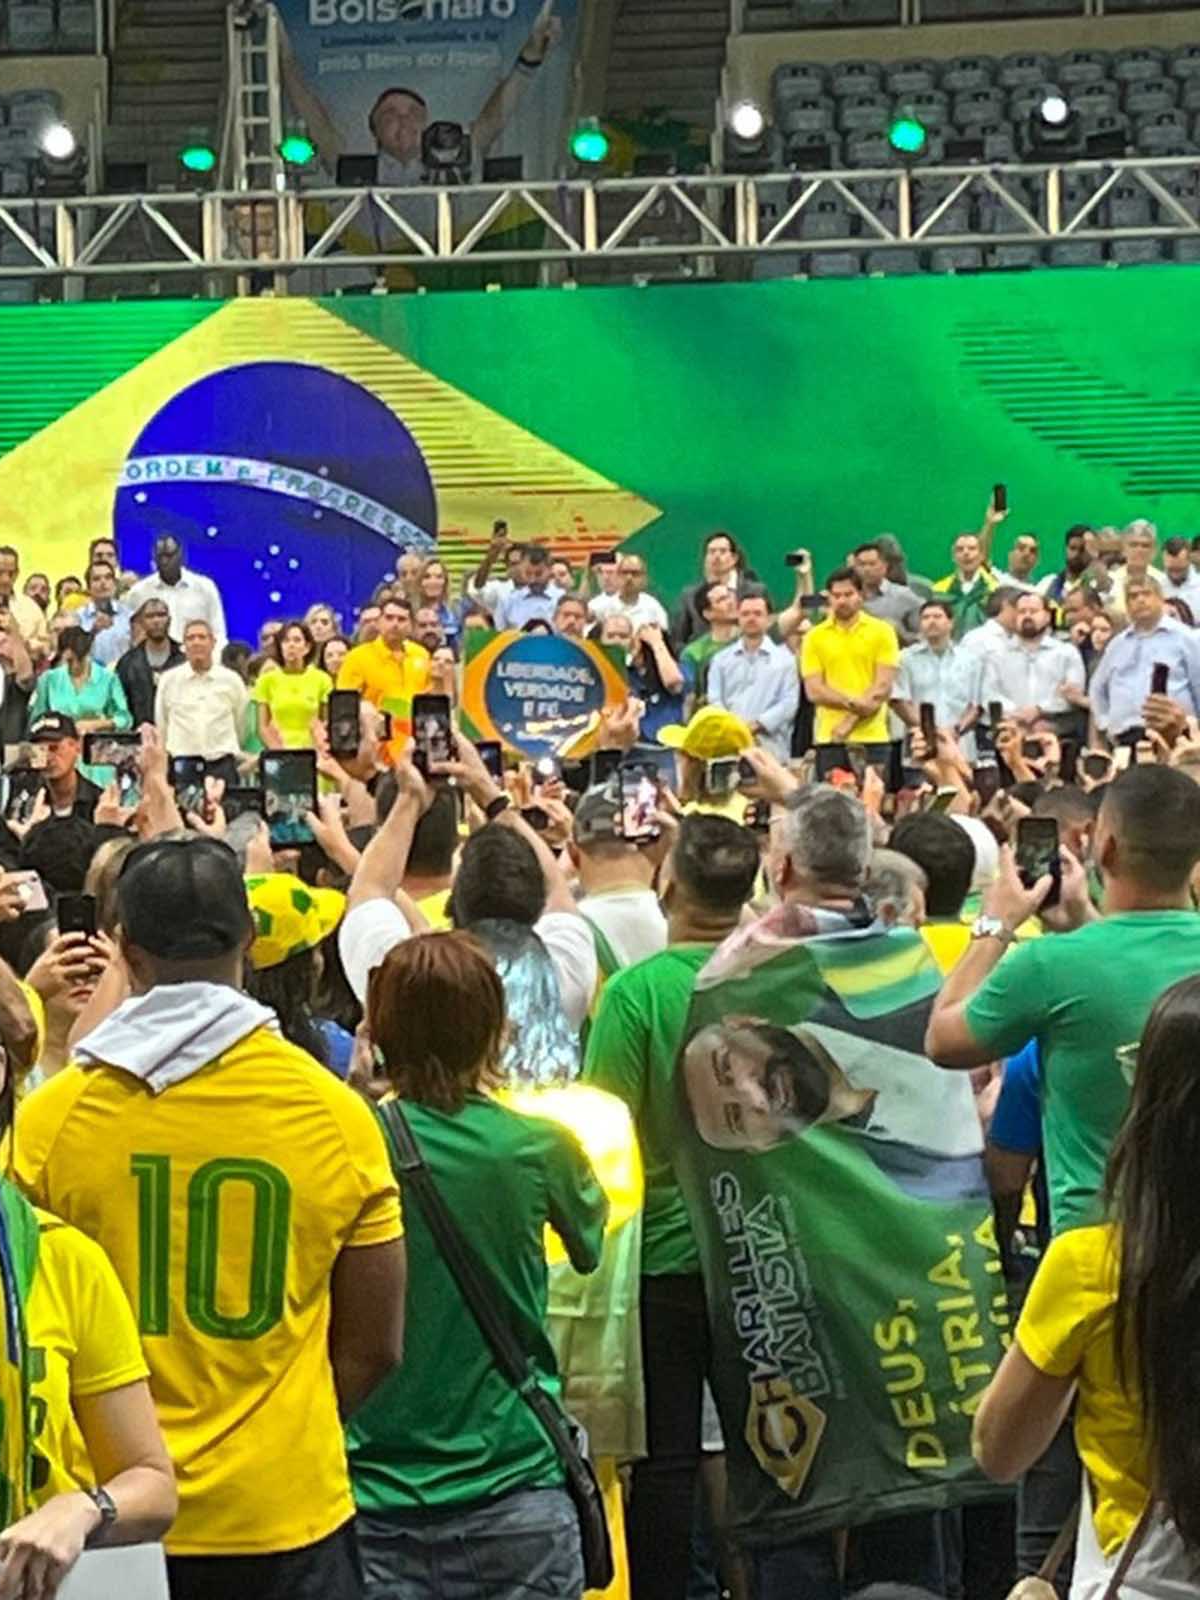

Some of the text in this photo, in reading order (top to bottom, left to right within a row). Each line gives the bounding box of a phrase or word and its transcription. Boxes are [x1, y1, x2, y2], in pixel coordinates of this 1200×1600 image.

[126, 457, 224, 481] ORDEM
[130, 1154, 292, 1340] 10
[743, 1194, 831, 1399] BATISTA
[927, 1234, 992, 1417] ÁTRIA,
[873, 1297, 948, 1469] DEUS,
